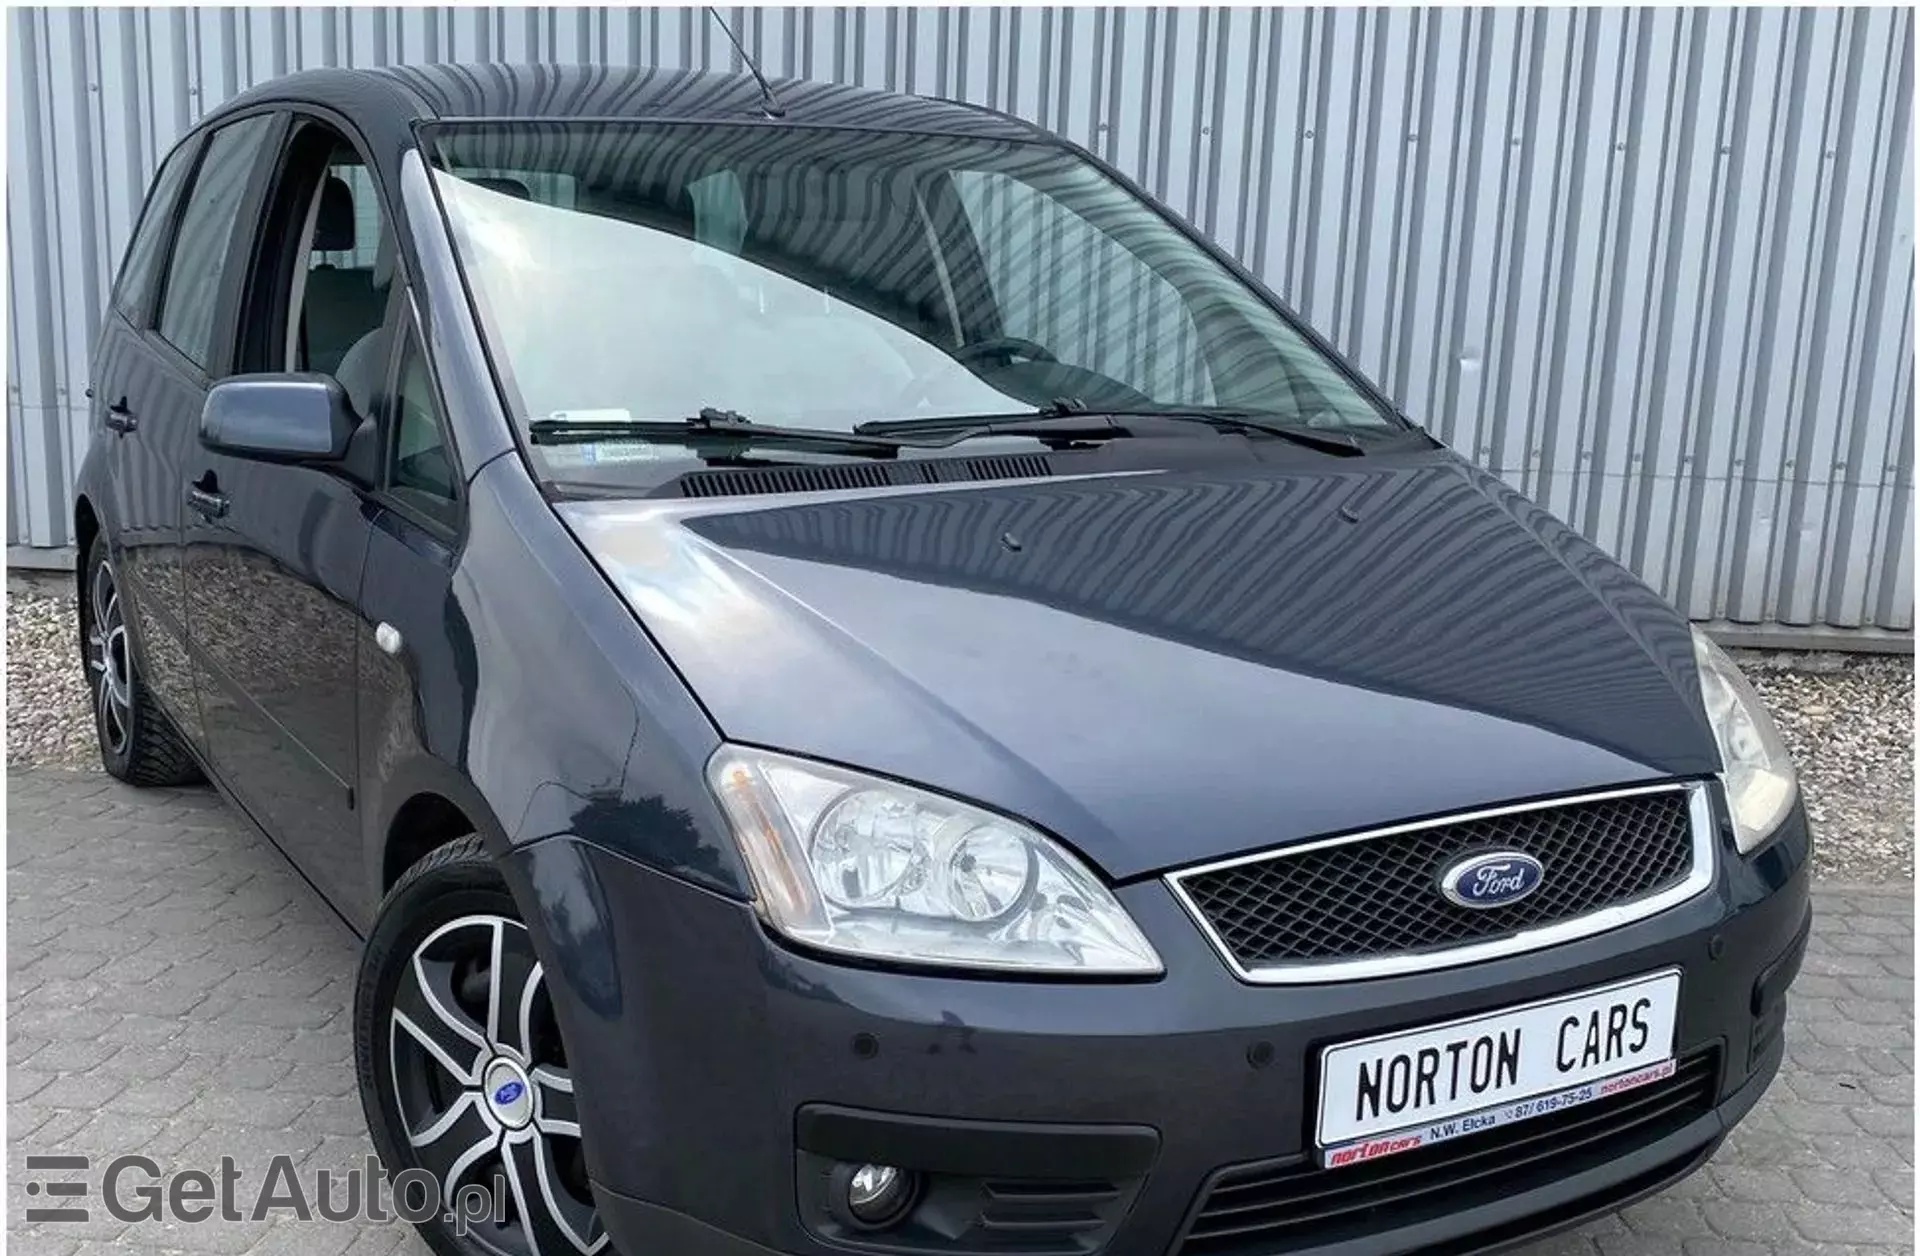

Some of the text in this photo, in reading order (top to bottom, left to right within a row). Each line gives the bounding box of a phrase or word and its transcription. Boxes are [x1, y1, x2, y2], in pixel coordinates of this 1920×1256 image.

[1473, 863, 1525, 897] Ford
[1356, 997, 1651, 1121] NORTON CARS
[1601, 1063, 1673, 1094] nortoncars.pl
